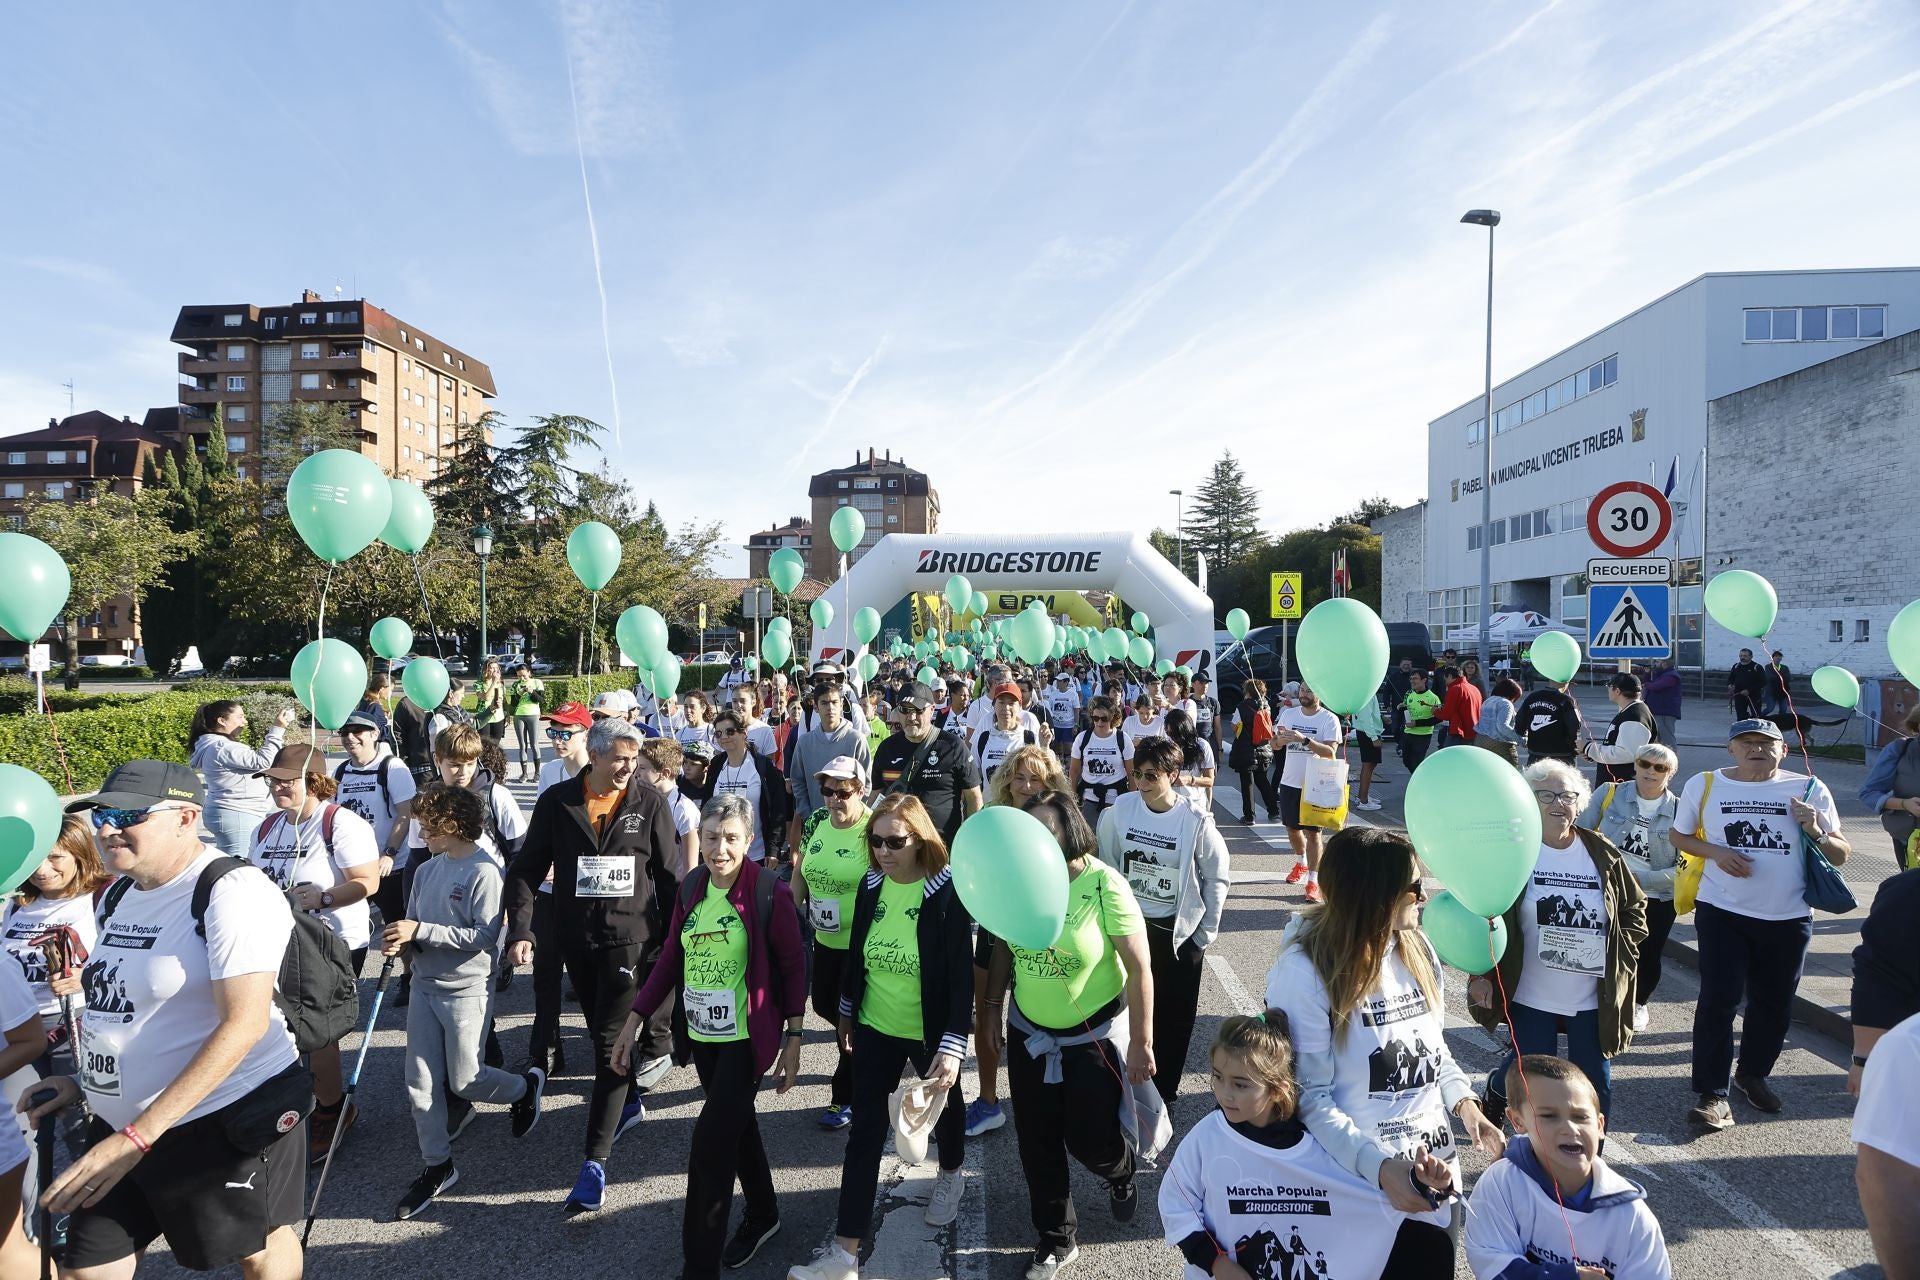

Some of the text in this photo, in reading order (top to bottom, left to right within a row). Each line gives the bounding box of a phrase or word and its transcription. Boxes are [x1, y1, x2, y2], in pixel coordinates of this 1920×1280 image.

[1462, 425, 1624, 496] PABELN MUNICIPAL VICENTE TRUEBA
[1610, 506, 1649, 532] 30
[916, 549, 1101, 573] BRIDGESTONE
[1592, 564, 1666, 576] RECUERDE
[1533, 714, 1552, 724] NIKE
[1752, 800, 1787, 808] Popular
[1128, 827, 1178, 842] Marcha Popular
[608, 869, 632, 881] 485
[1533, 870, 1563, 878] Marcha
[1157, 878, 1171, 890] 45
[1544, 879, 1590, 889] BRIDGESTONE
[820, 910, 833, 921] 44
[109, 921, 164, 935] Marcha Popular
[1543, 933, 1564, 941] Marcha
[887, 962, 915, 977] VIDA
[1038, 964, 1070, 978] VIDA
[700, 972, 726, 986] VIDA
[707, 1005, 729, 1020] 197
[87, 1051, 116, 1075] 308
[1377, 1119, 1405, 1129] Marcha
[1420, 1124, 1450, 1154] 346
[1226, 1185, 1328, 1198] Marcha Popular
[1245, 1202, 1314, 1213] BRIDGESTONE
